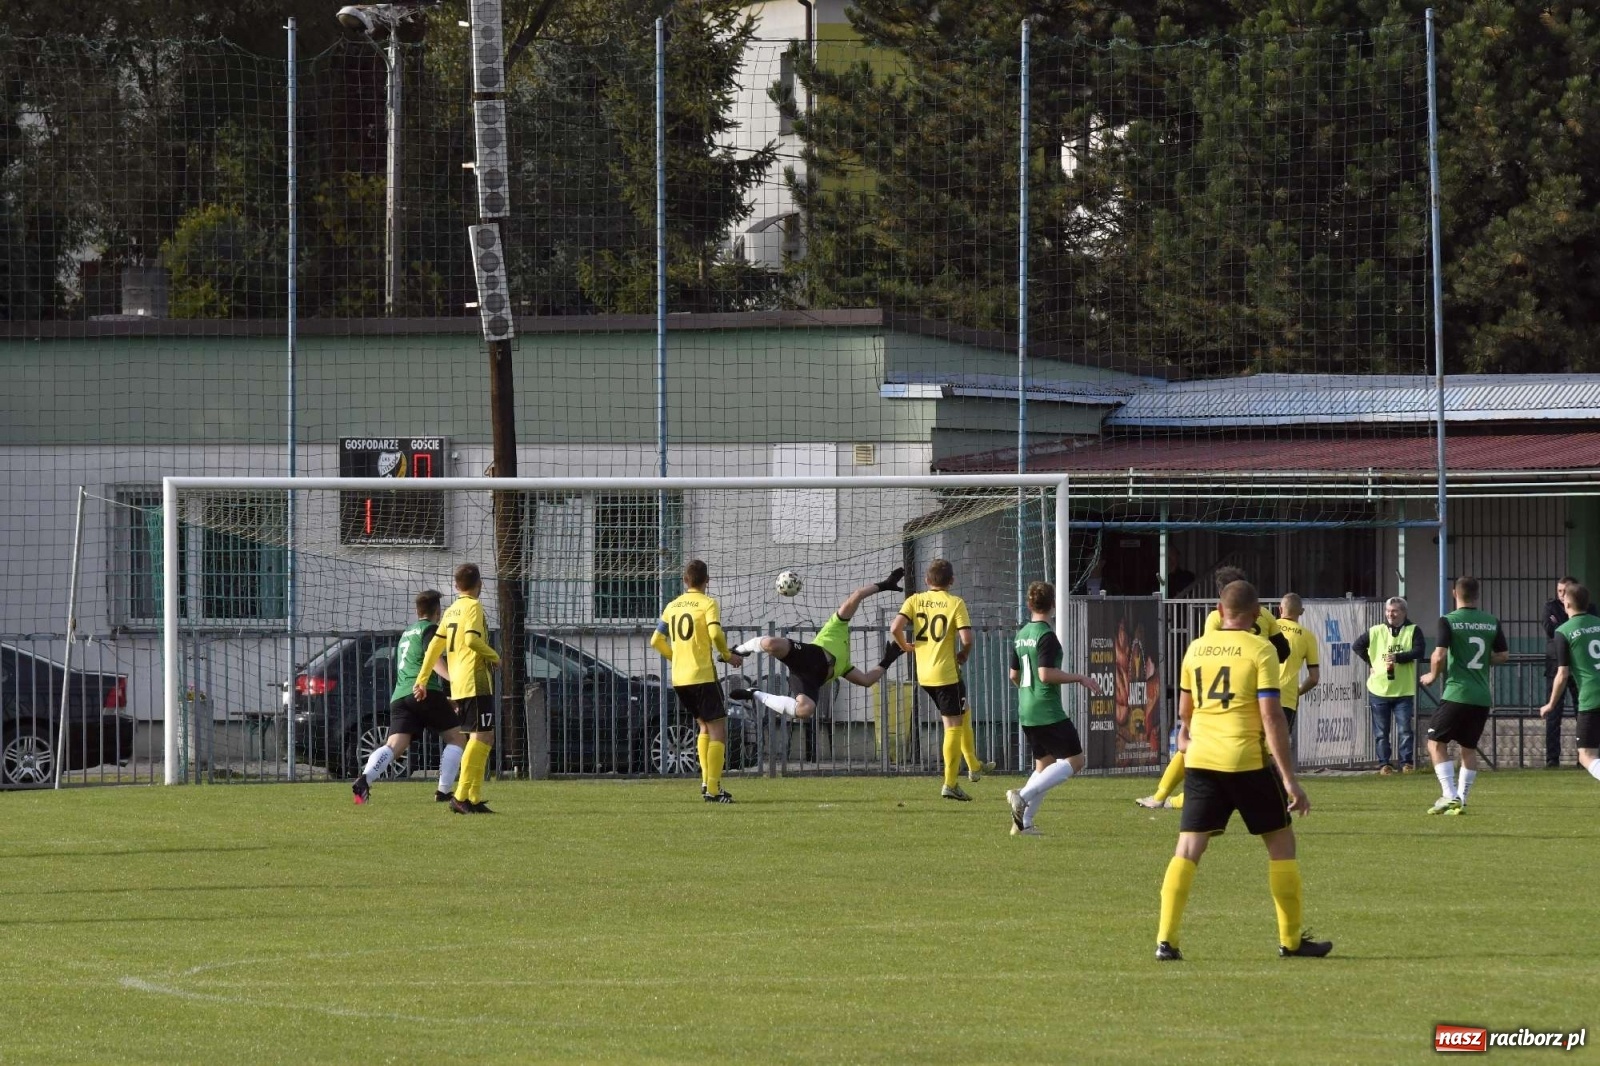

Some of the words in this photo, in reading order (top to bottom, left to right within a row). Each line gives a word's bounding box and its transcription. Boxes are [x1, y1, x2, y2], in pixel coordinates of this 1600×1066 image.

[345, 439, 399, 450] GOSPODARZE
[671, 613, 694, 642] 10
[915, 612, 948, 643] 20
[1467, 637, 1485, 670] 2
[1194, 665, 1236, 709] 14
[481, 713, 493, 727] 17
